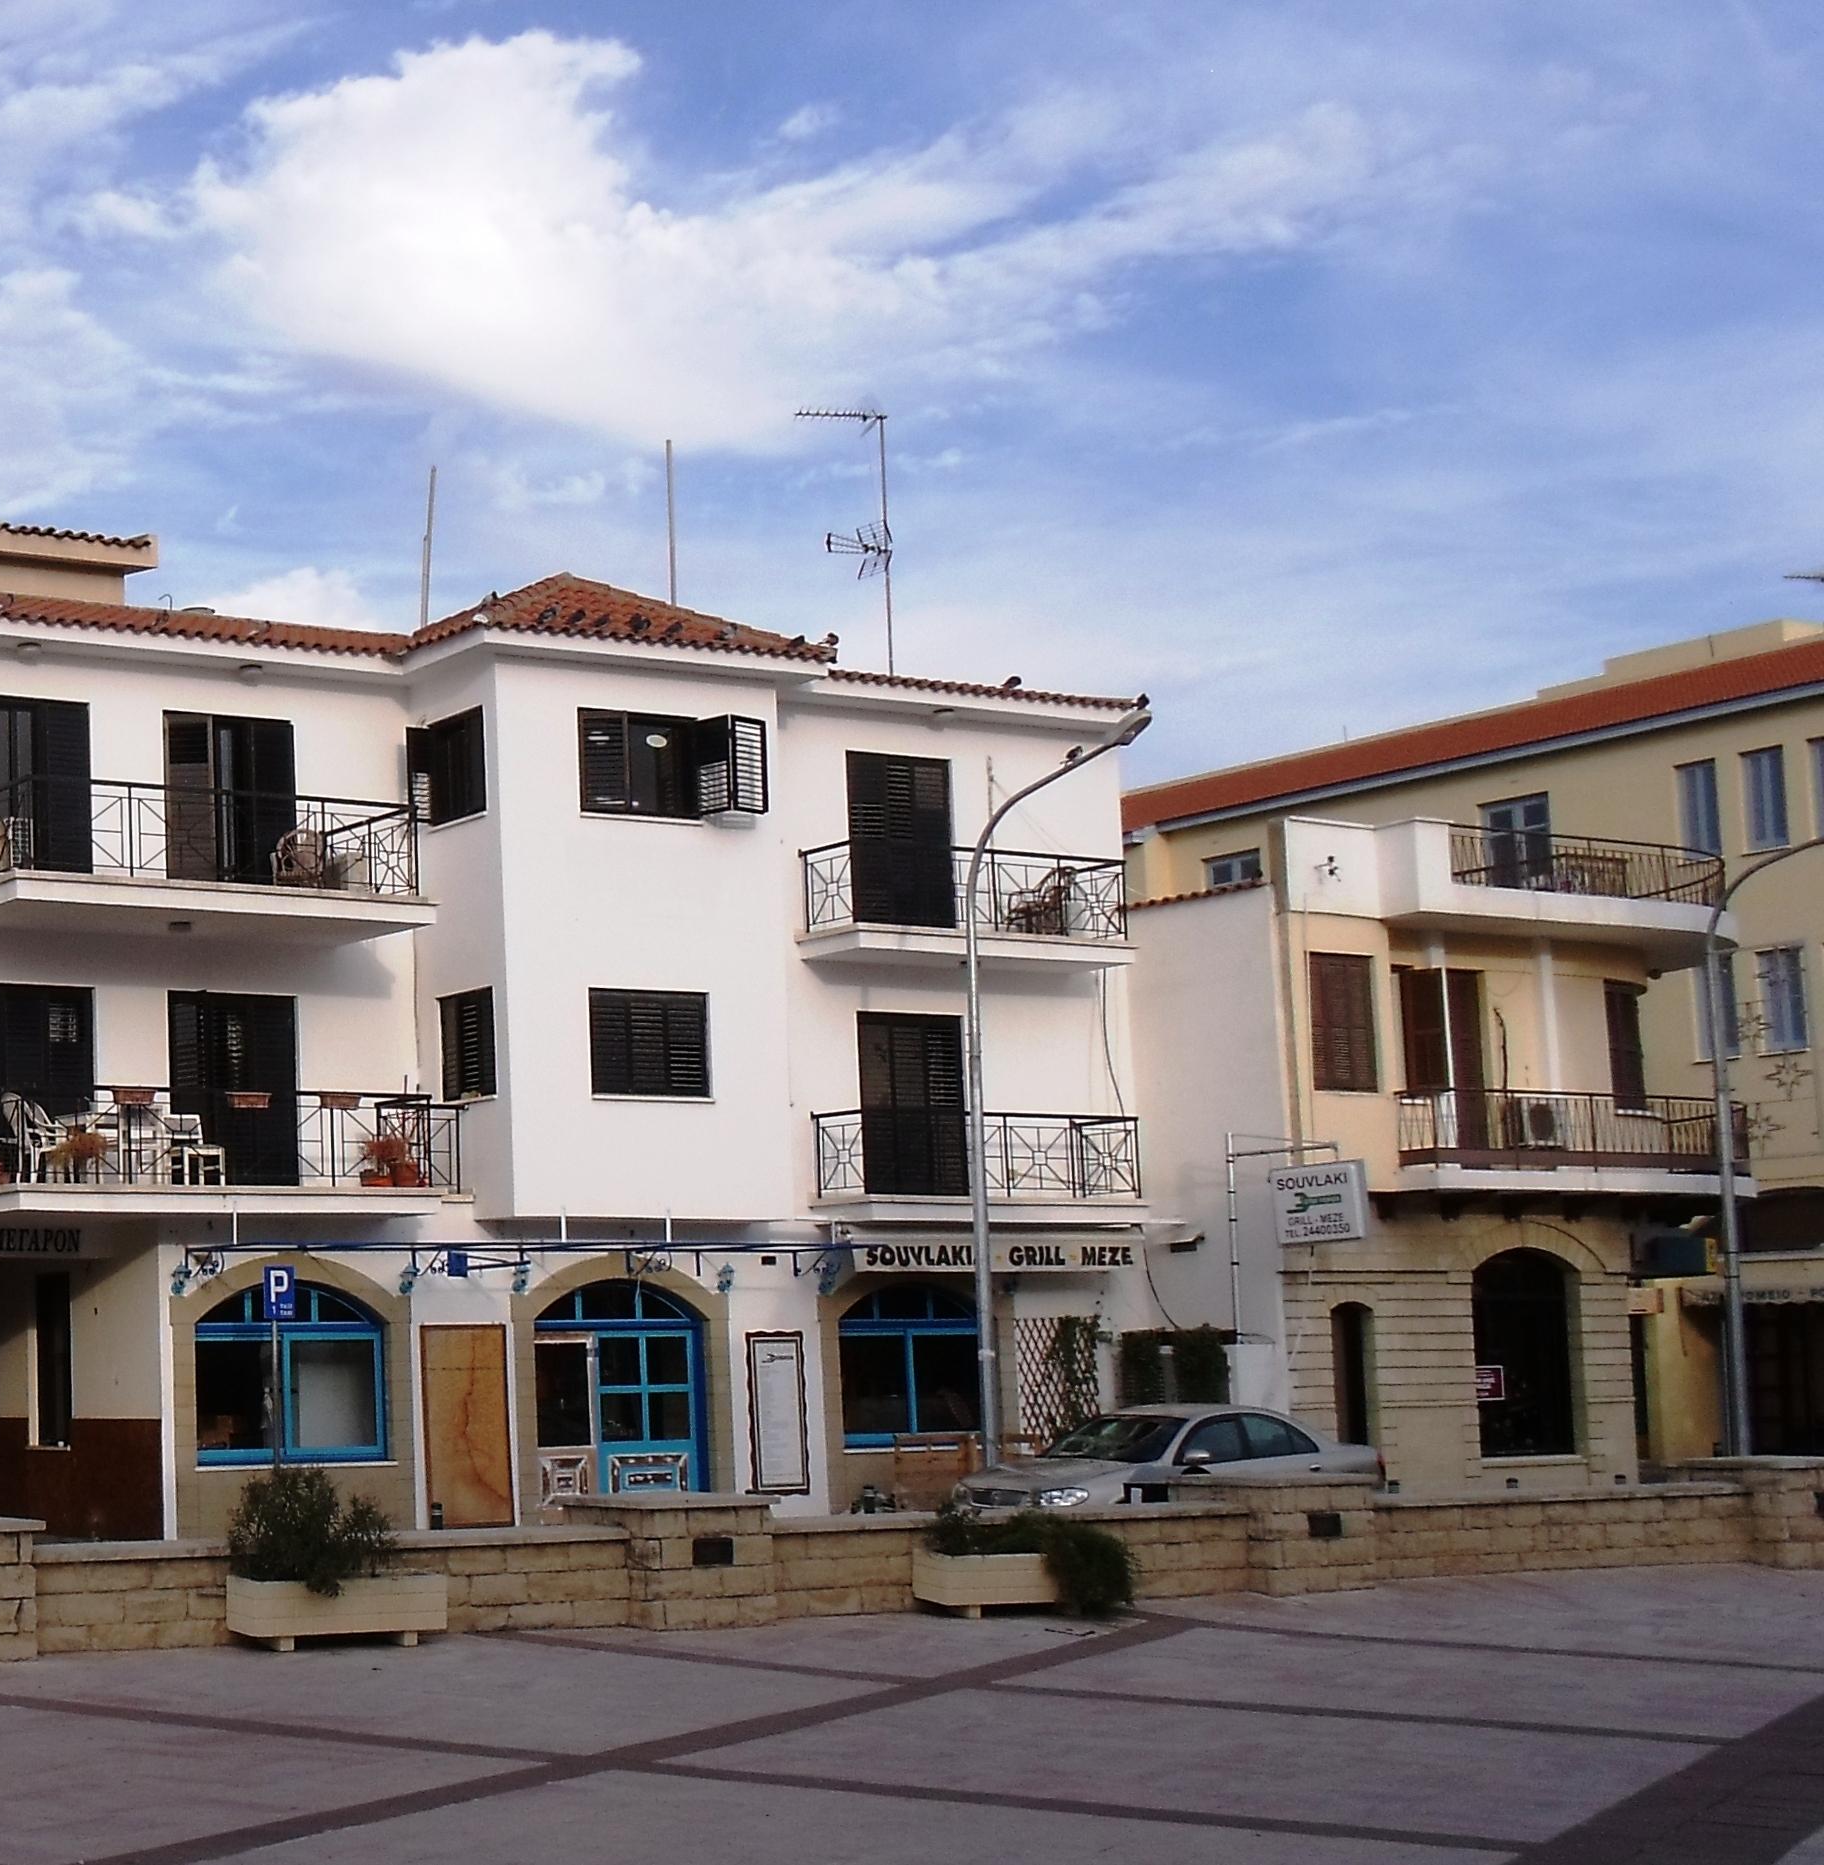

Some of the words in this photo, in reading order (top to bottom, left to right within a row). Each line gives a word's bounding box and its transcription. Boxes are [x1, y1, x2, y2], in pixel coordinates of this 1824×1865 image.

[1277, 1172, 1348, 1191] SOUVLAKI
[866, 1245, 974, 1267] SOUVLAKI
[1008, 1246, 1066, 1267] GRILL
[1081, 1246, 1133, 1266] MEZE
[270, 1270, 289, 1303] P
